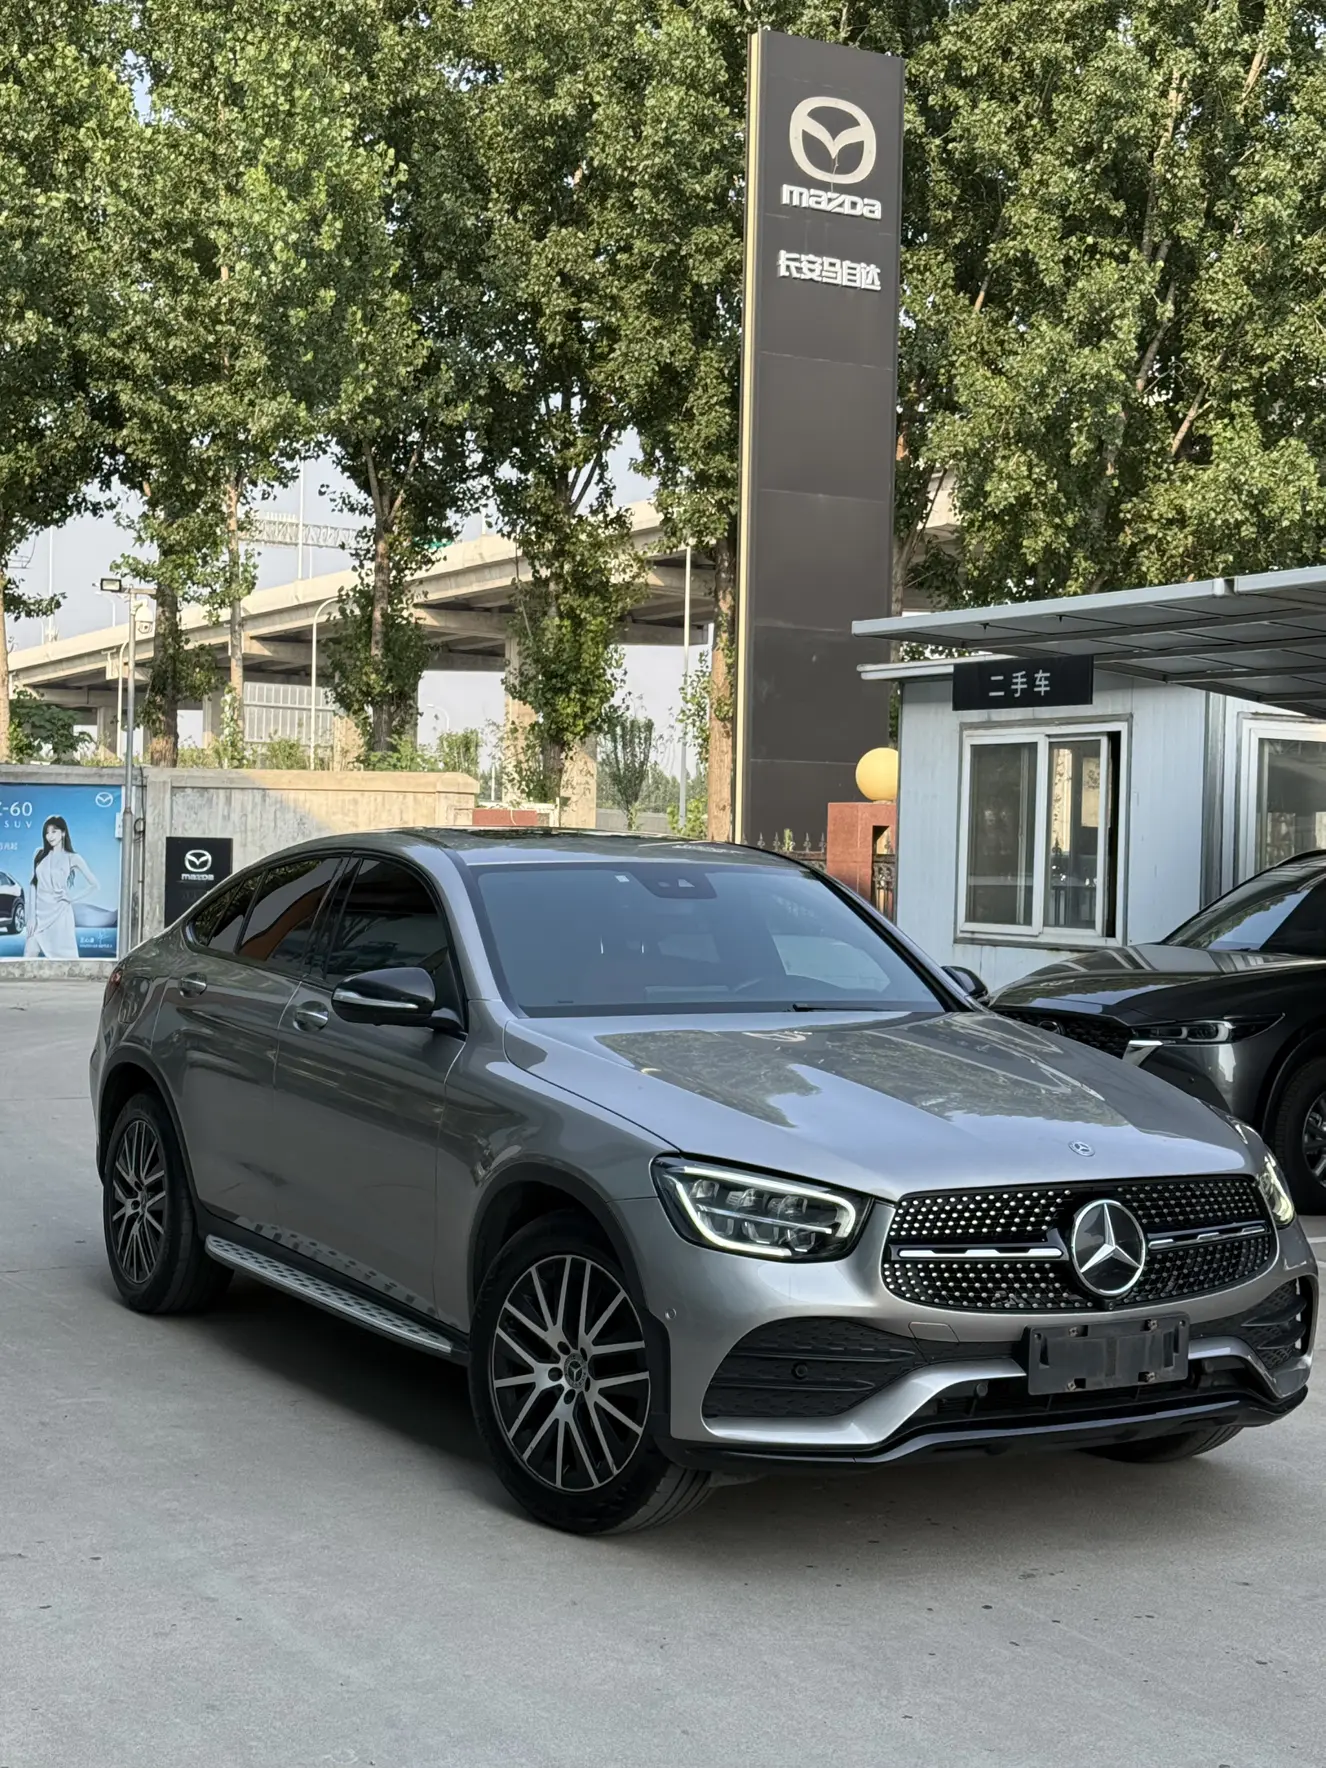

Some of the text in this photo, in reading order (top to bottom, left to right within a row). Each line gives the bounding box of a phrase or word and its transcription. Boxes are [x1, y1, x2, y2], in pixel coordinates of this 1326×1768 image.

[781, 183, 882, 220] mazda
[777, 249, 881, 291] 长安马自达
[988, 669, 1051, 698] 二手车
[0, 801, 33, 816] -60
